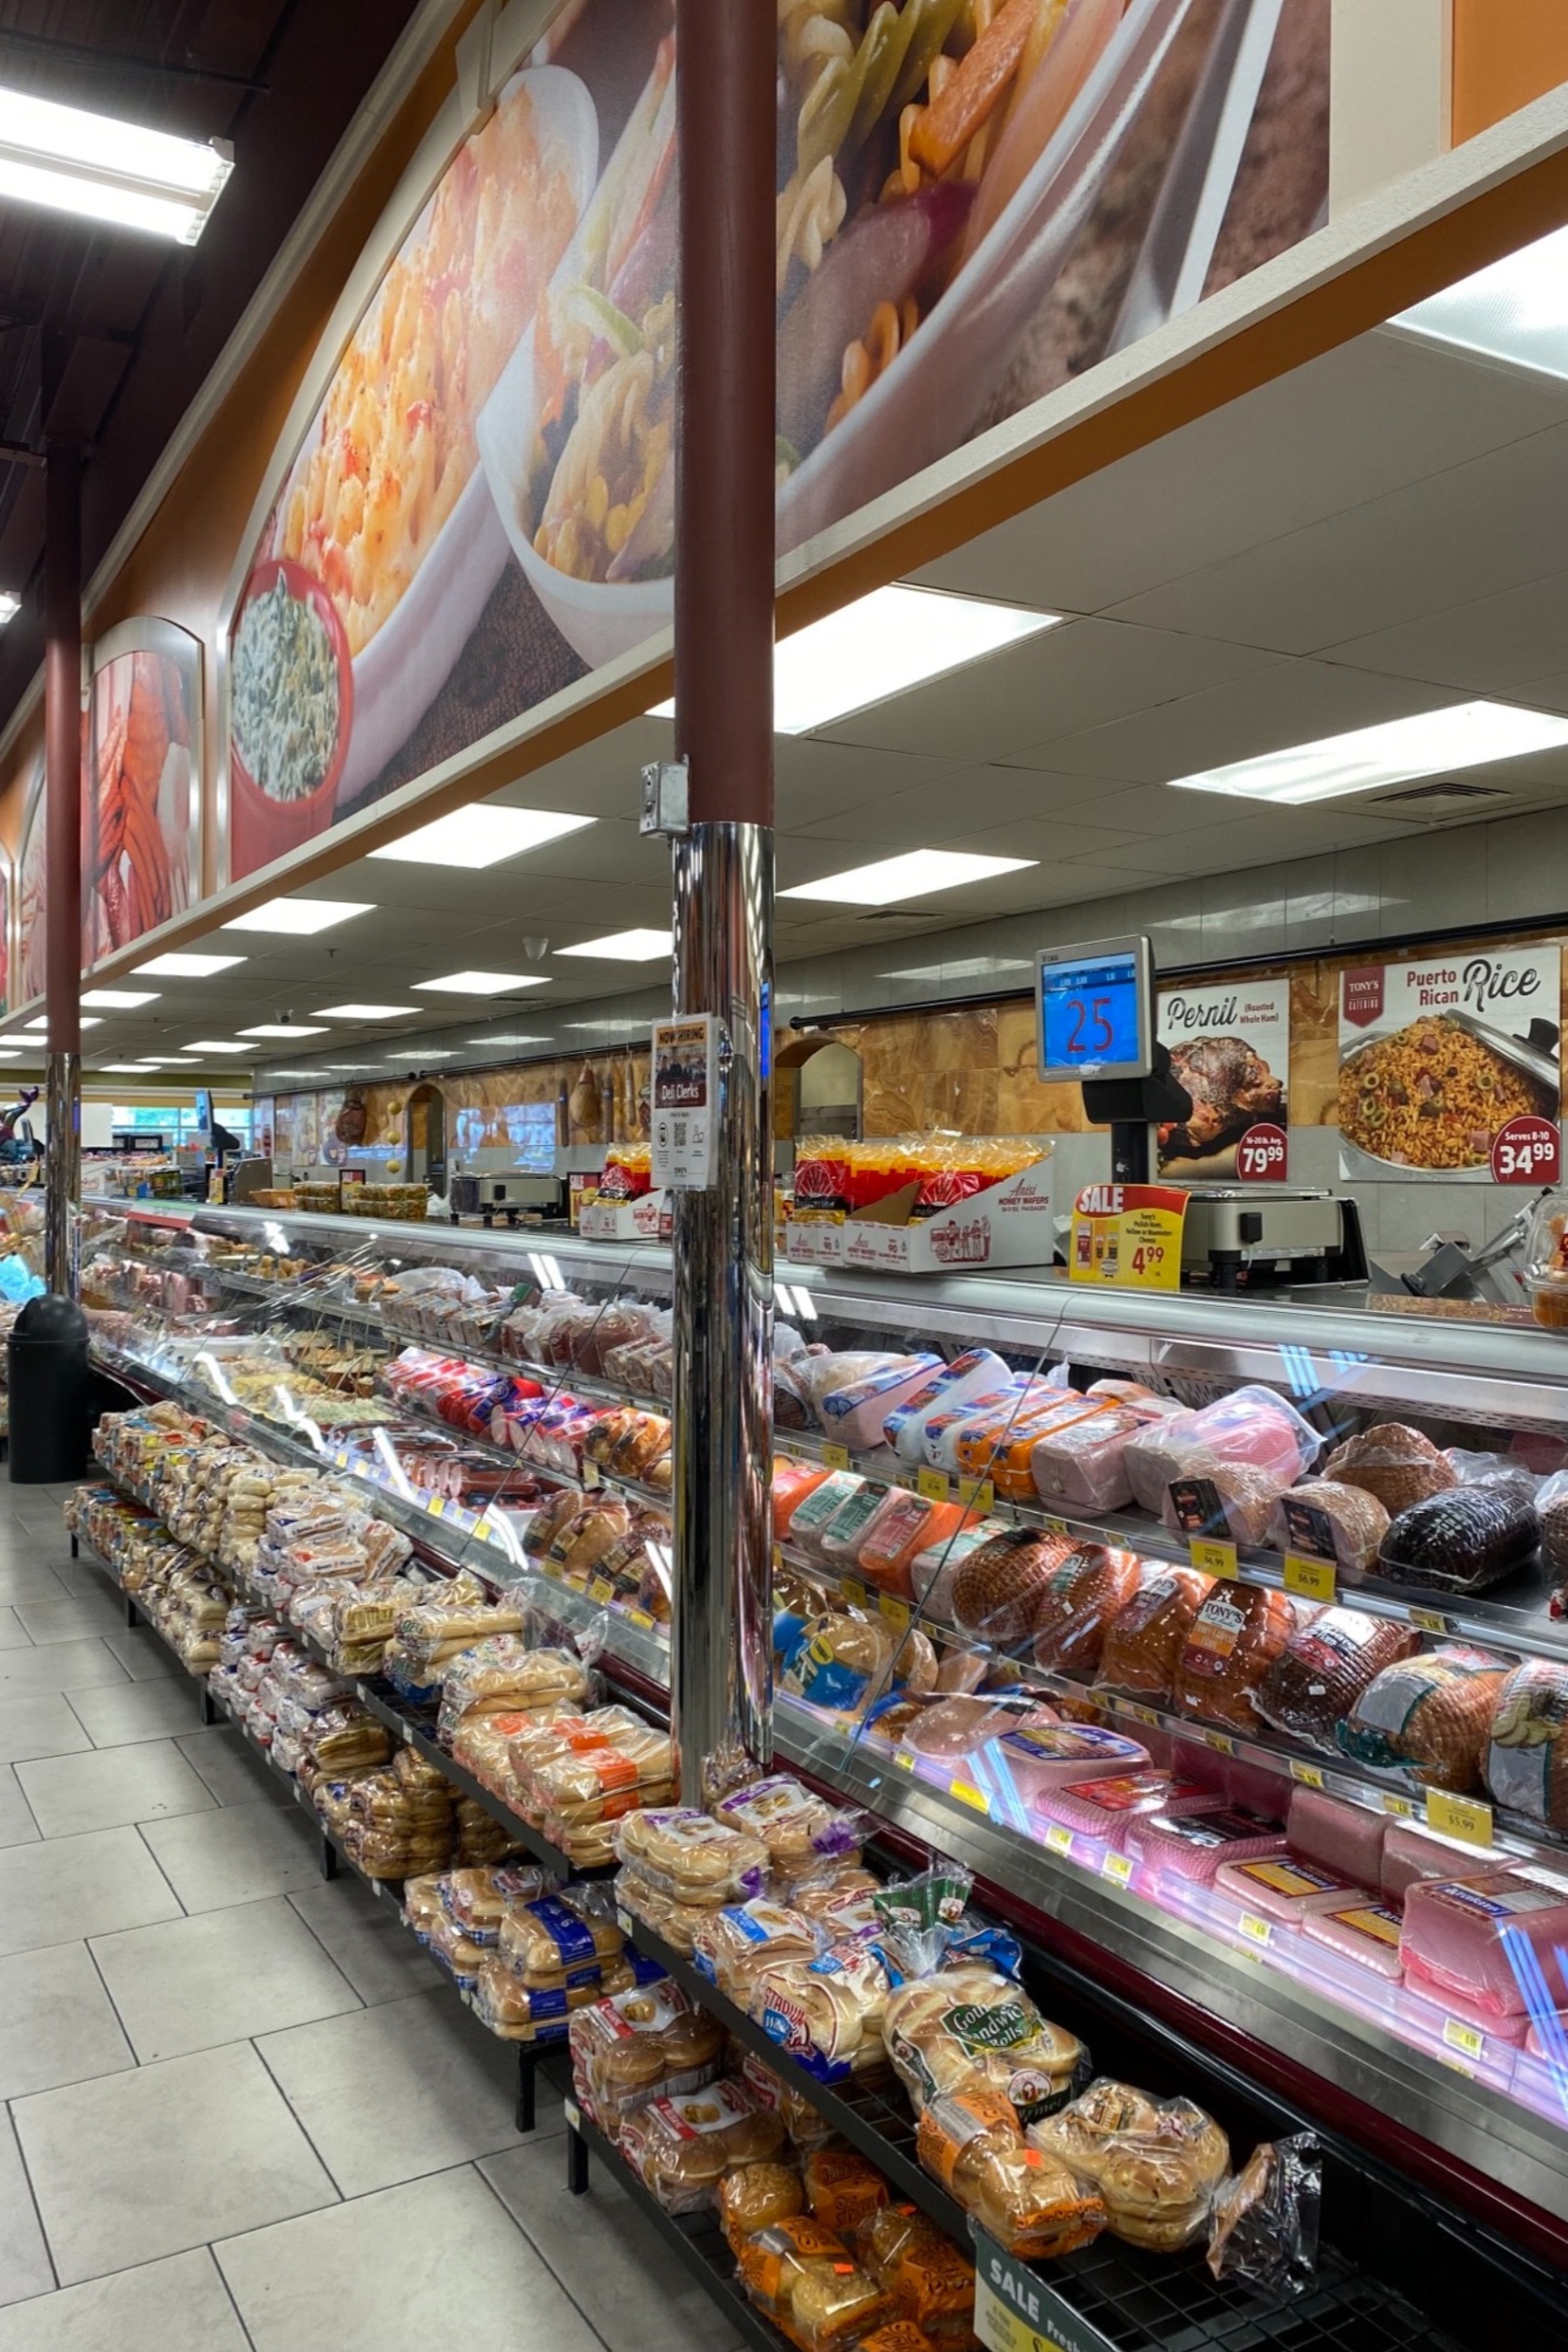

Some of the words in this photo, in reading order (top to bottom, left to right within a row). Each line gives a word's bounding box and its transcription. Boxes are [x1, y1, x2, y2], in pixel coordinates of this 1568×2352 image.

[1349, 979, 1380, 992] TONY'S
[1407, 969, 1456, 988] Puerto
[1463, 958, 1541, 1012] Rice
[1244, 1001, 1275, 1013] (Roasted
[1349, 998, 1379, 1011] CATERING
[1419, 990, 1459, 1006] Rican
[1167, 995, 1238, 1029] Pernil
[1239, 1015, 1260, 1024] Whole
[1260, 1013, 1280, 1023] Ham)
[1067, 996, 1115, 1053] 25
[661, 1084, 676, 1101] Deli
[676, 1083, 699, 1099] Clerks
[1505, 1131, 1531, 1141] Serves
[1532, 1130, 1551, 1141] 8-10
[1080, 1187, 1124, 1214] SALE
[1203, 1556, 1225, 1567] $6.99
[1297, 1572, 1320, 1587] $6.99
[1205, 1602, 1245, 1625] TONY'S
[1448, 1814, 1475, 1832] $5.99
[764, 1986, 806, 2029] STADIUM
[960, 2002, 1025, 2040] Sandwic
[989, 2026, 1024, 2047] Rolls
[989, 2259, 1040, 2323] SALE
